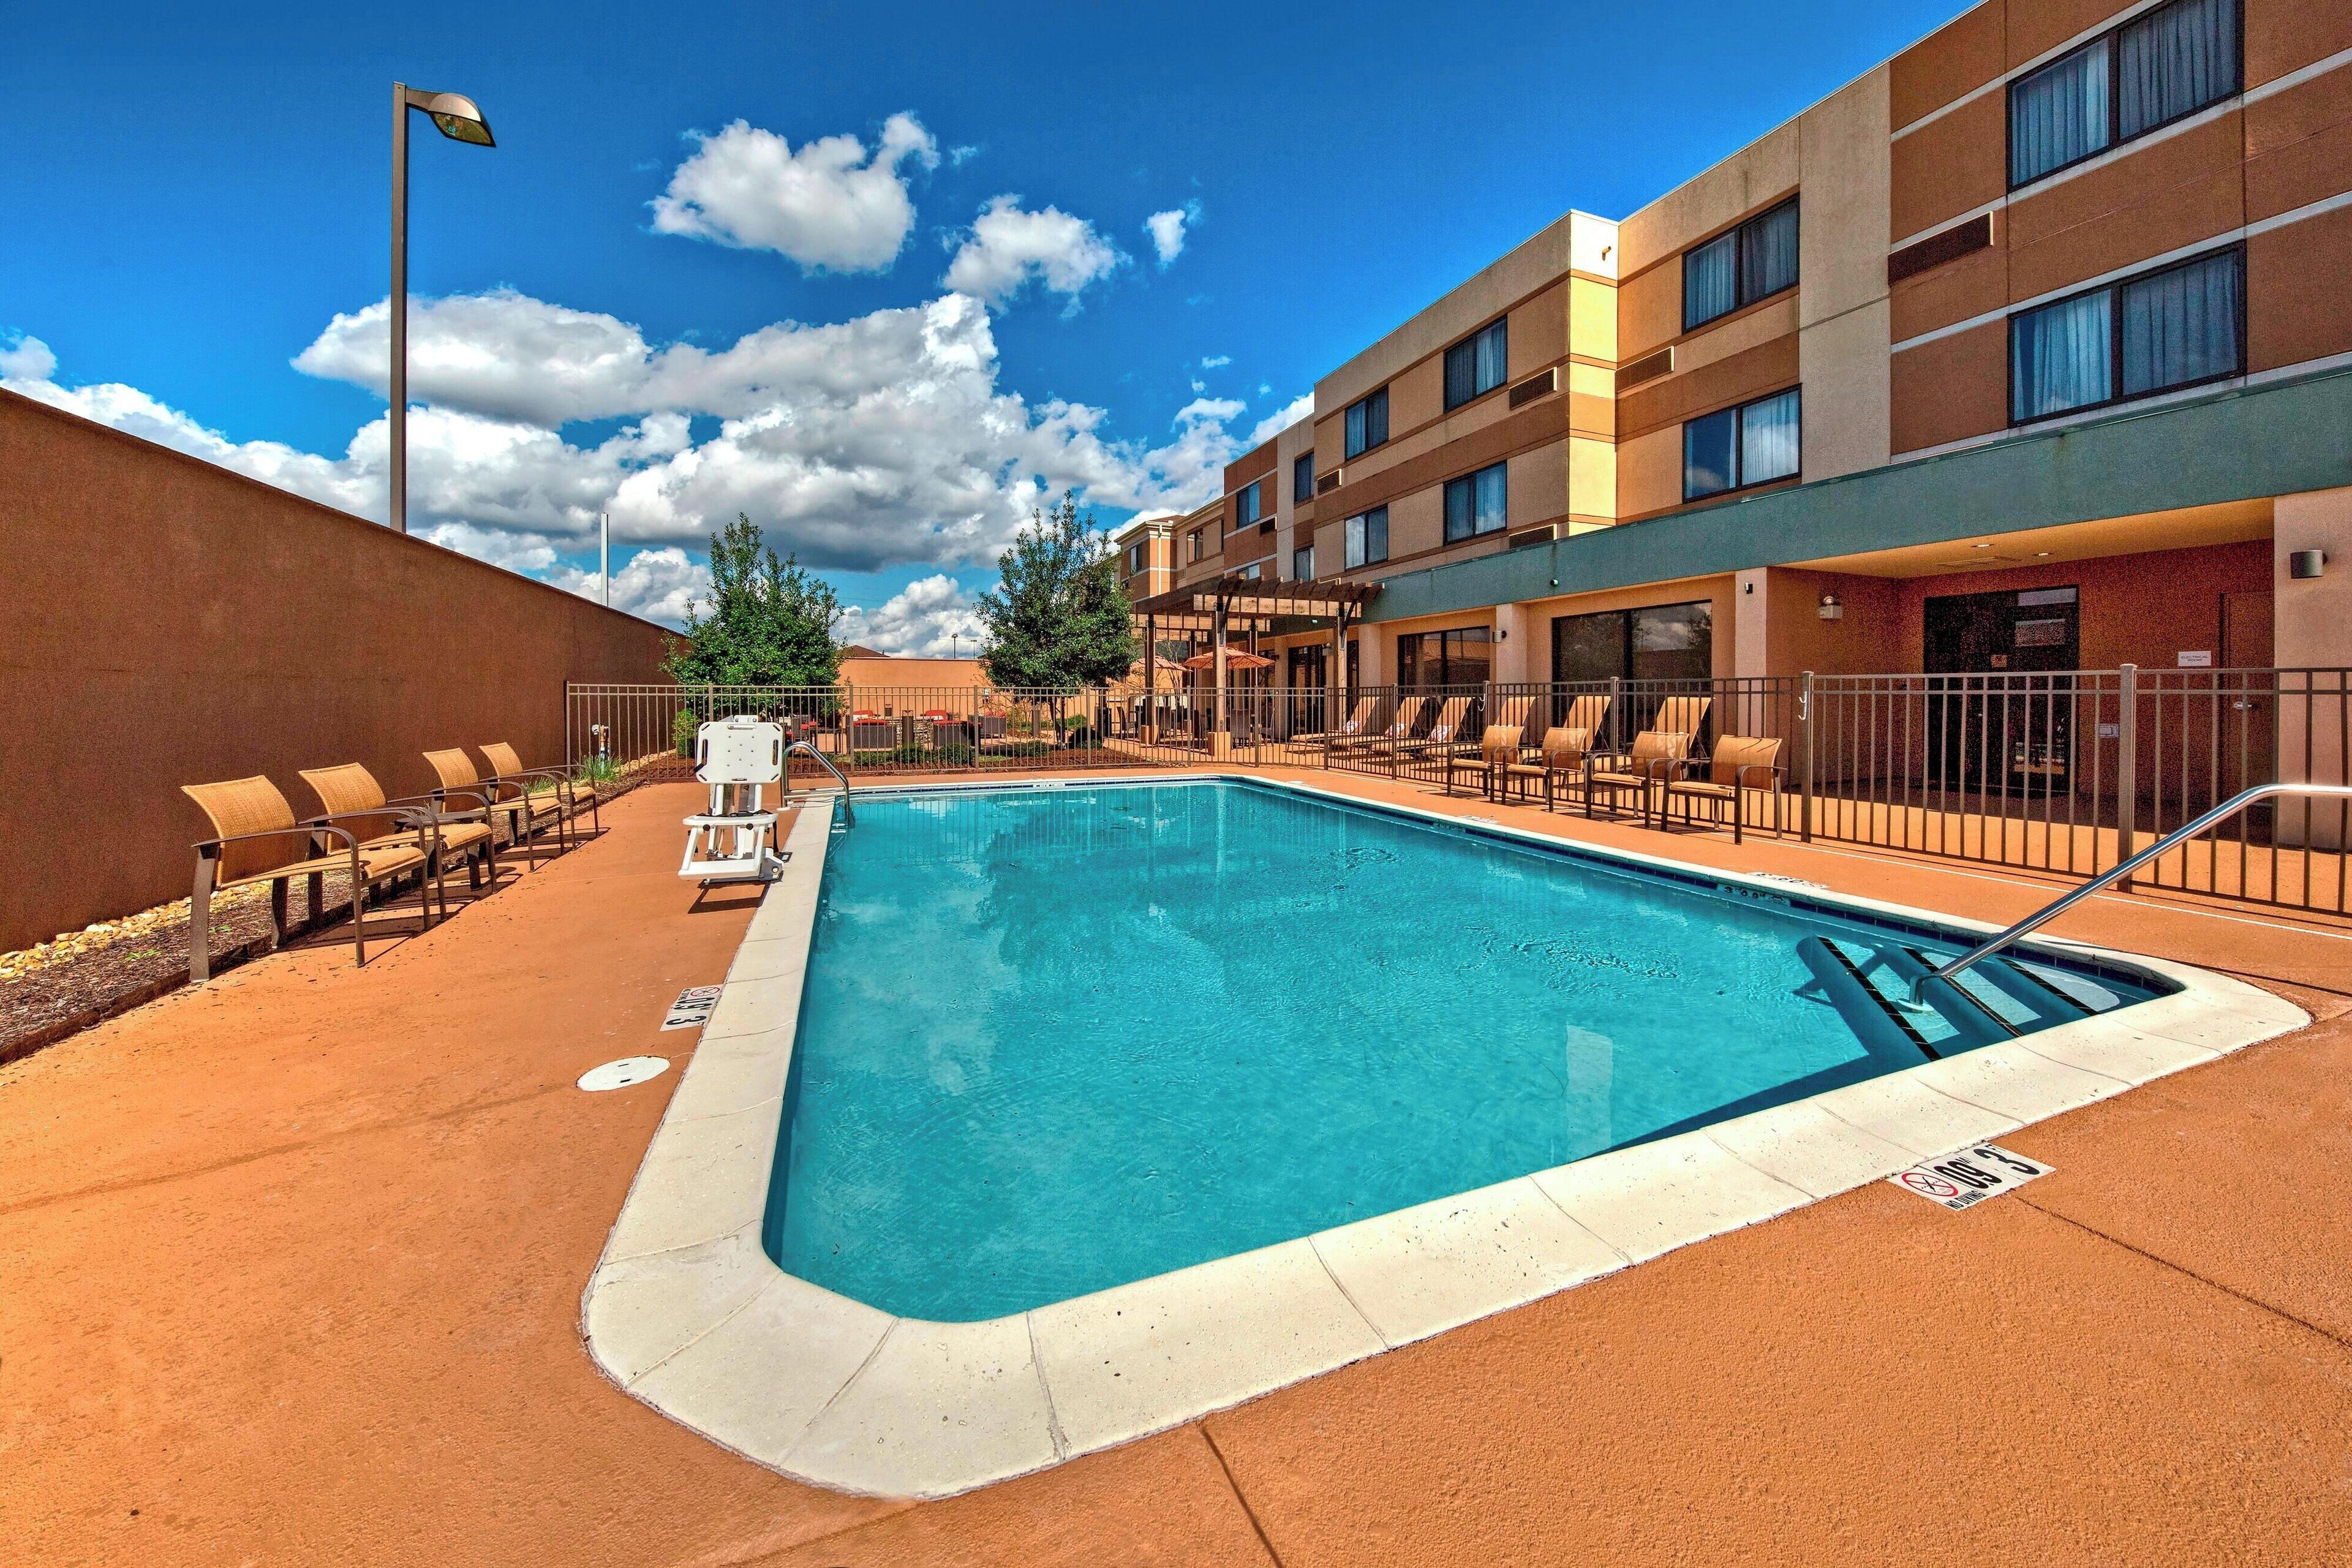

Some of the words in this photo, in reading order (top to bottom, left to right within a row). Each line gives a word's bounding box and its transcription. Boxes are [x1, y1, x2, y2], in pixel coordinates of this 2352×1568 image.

[666, 1016, 707, 1025] 3
[1973, 1148, 2040, 1175] 3
[1944, 1200, 1964, 1210] NO
[1954, 1191, 1987, 1205] DIVING
